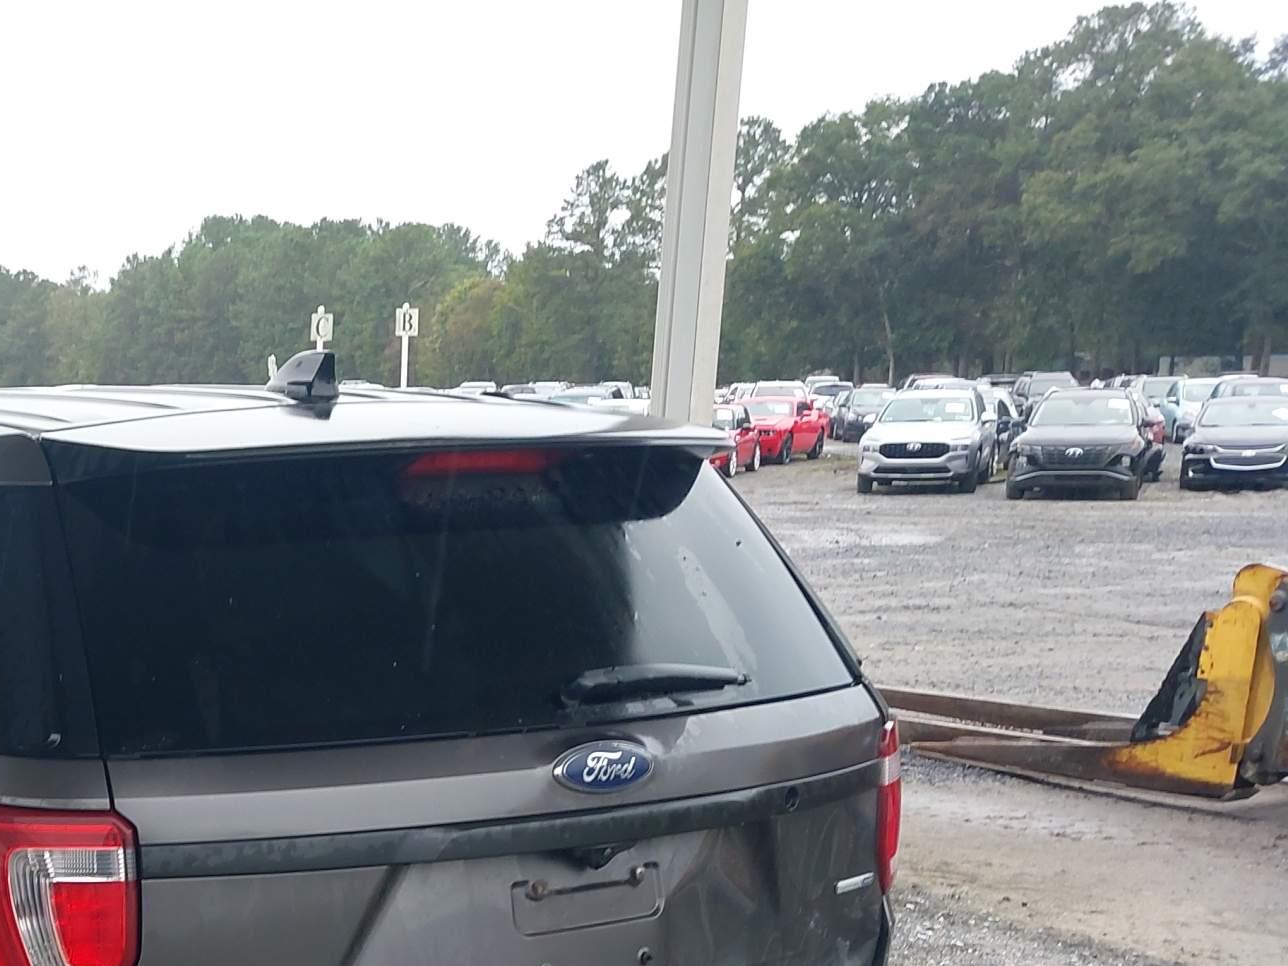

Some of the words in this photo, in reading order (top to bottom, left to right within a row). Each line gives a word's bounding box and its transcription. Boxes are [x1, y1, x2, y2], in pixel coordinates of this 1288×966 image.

[316, 316, 329, 338] C
[402, 313, 413, 332] B
[583, 751, 637, 783] Ford
